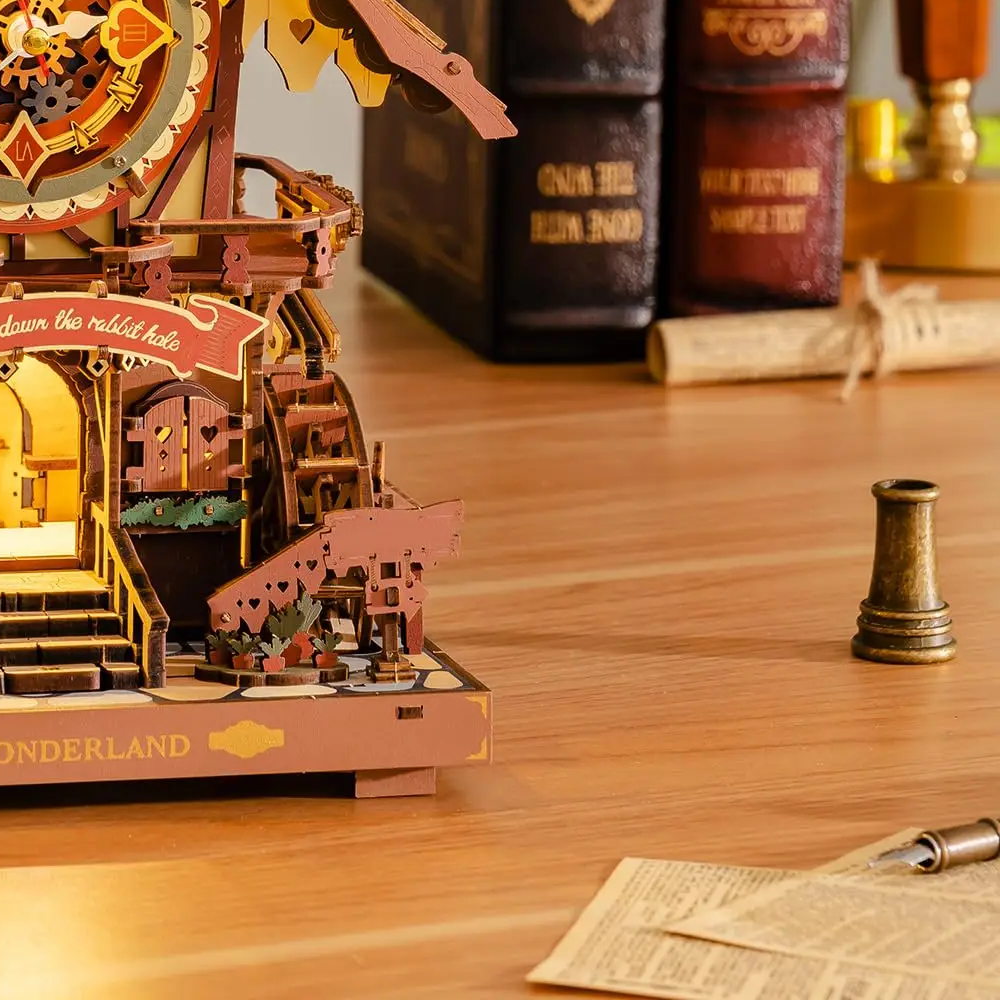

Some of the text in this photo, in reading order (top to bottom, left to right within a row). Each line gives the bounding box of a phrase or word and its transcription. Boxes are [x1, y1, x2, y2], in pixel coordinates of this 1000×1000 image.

[123, 23, 147, 42] III
[54, 308, 83, 330] the
[87, 314, 145, 340] rabbit
[141, 324, 180, 351] hole
